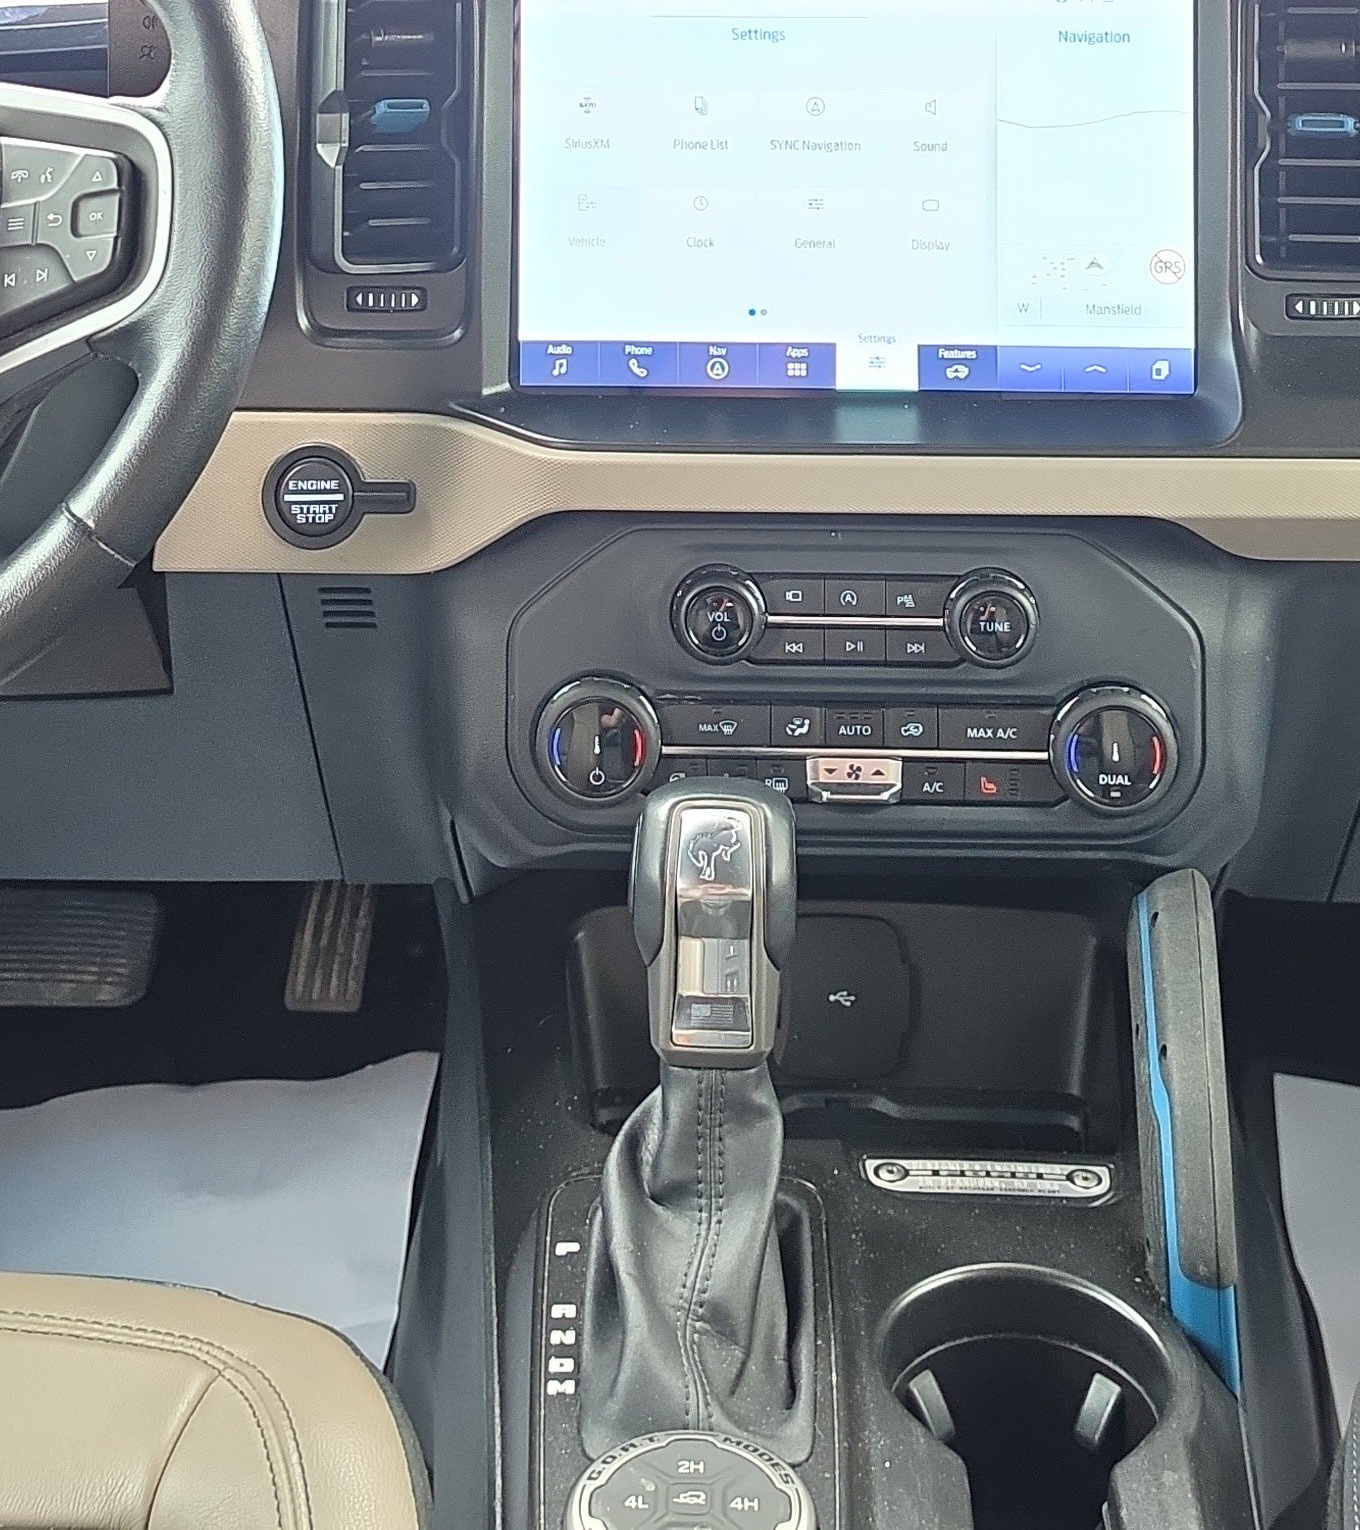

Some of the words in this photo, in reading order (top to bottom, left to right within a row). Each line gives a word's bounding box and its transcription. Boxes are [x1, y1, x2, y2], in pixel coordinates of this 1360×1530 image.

[732, 27, 786, 44] Settings
[1058, 30, 1130, 45] Navigation
[564, 137, 611, 151] SiriusXM
[673, 138, 708, 151] Phone
[710, 138, 729, 151] List
[770, 139, 800, 152] SYNC
[802, 139, 861, 154] Navigation
[913, 139, 948, 152] Sound
[89, 211, 103, 221] OK
[568, 236, 606, 248] Vehicle
[686, 236, 715, 248] Clock
[794, 237, 836, 249] General
[911, 238, 950, 252] Display
[1018, 302, 1029, 314] W
[1086, 303, 1142, 316] Mansfield
[858, 333, 896, 345] Settings
[546, 344, 573, 356] Audio
[624, 345, 653, 356] Phone
[708, 346, 727, 357] Nav
[786, 346, 809, 359] Apps
[938, 348, 977, 359] Features
[288, 480, 340, 491] ENGINE
[290, 504, 339, 514] START
[296, 513, 334, 524] STOP
[707, 611, 731, 622] VOL
[978, 621, 1011, 632] TUNE
[698, 723, 719, 732] MAX
[838, 724, 872, 736] AUTO
[966, 727, 995, 739] MAX
[996, 728, 1018, 739] A/C
[1098, 774, 1132, 786] DUAL
[922, 782, 944, 793] A/C
[555, 1241, 581, 1256] P
[549, 1328, 576, 1345] N
[548, 1357, 575, 1373] D
[546, 1379, 576, 1395] M
[677, 1460, 705, 1474] 2H
[722, 1436, 796, 1486] MODES
[624, 1495, 649, 1509] 4L
[729, 1497, 759, 1511] 4H
